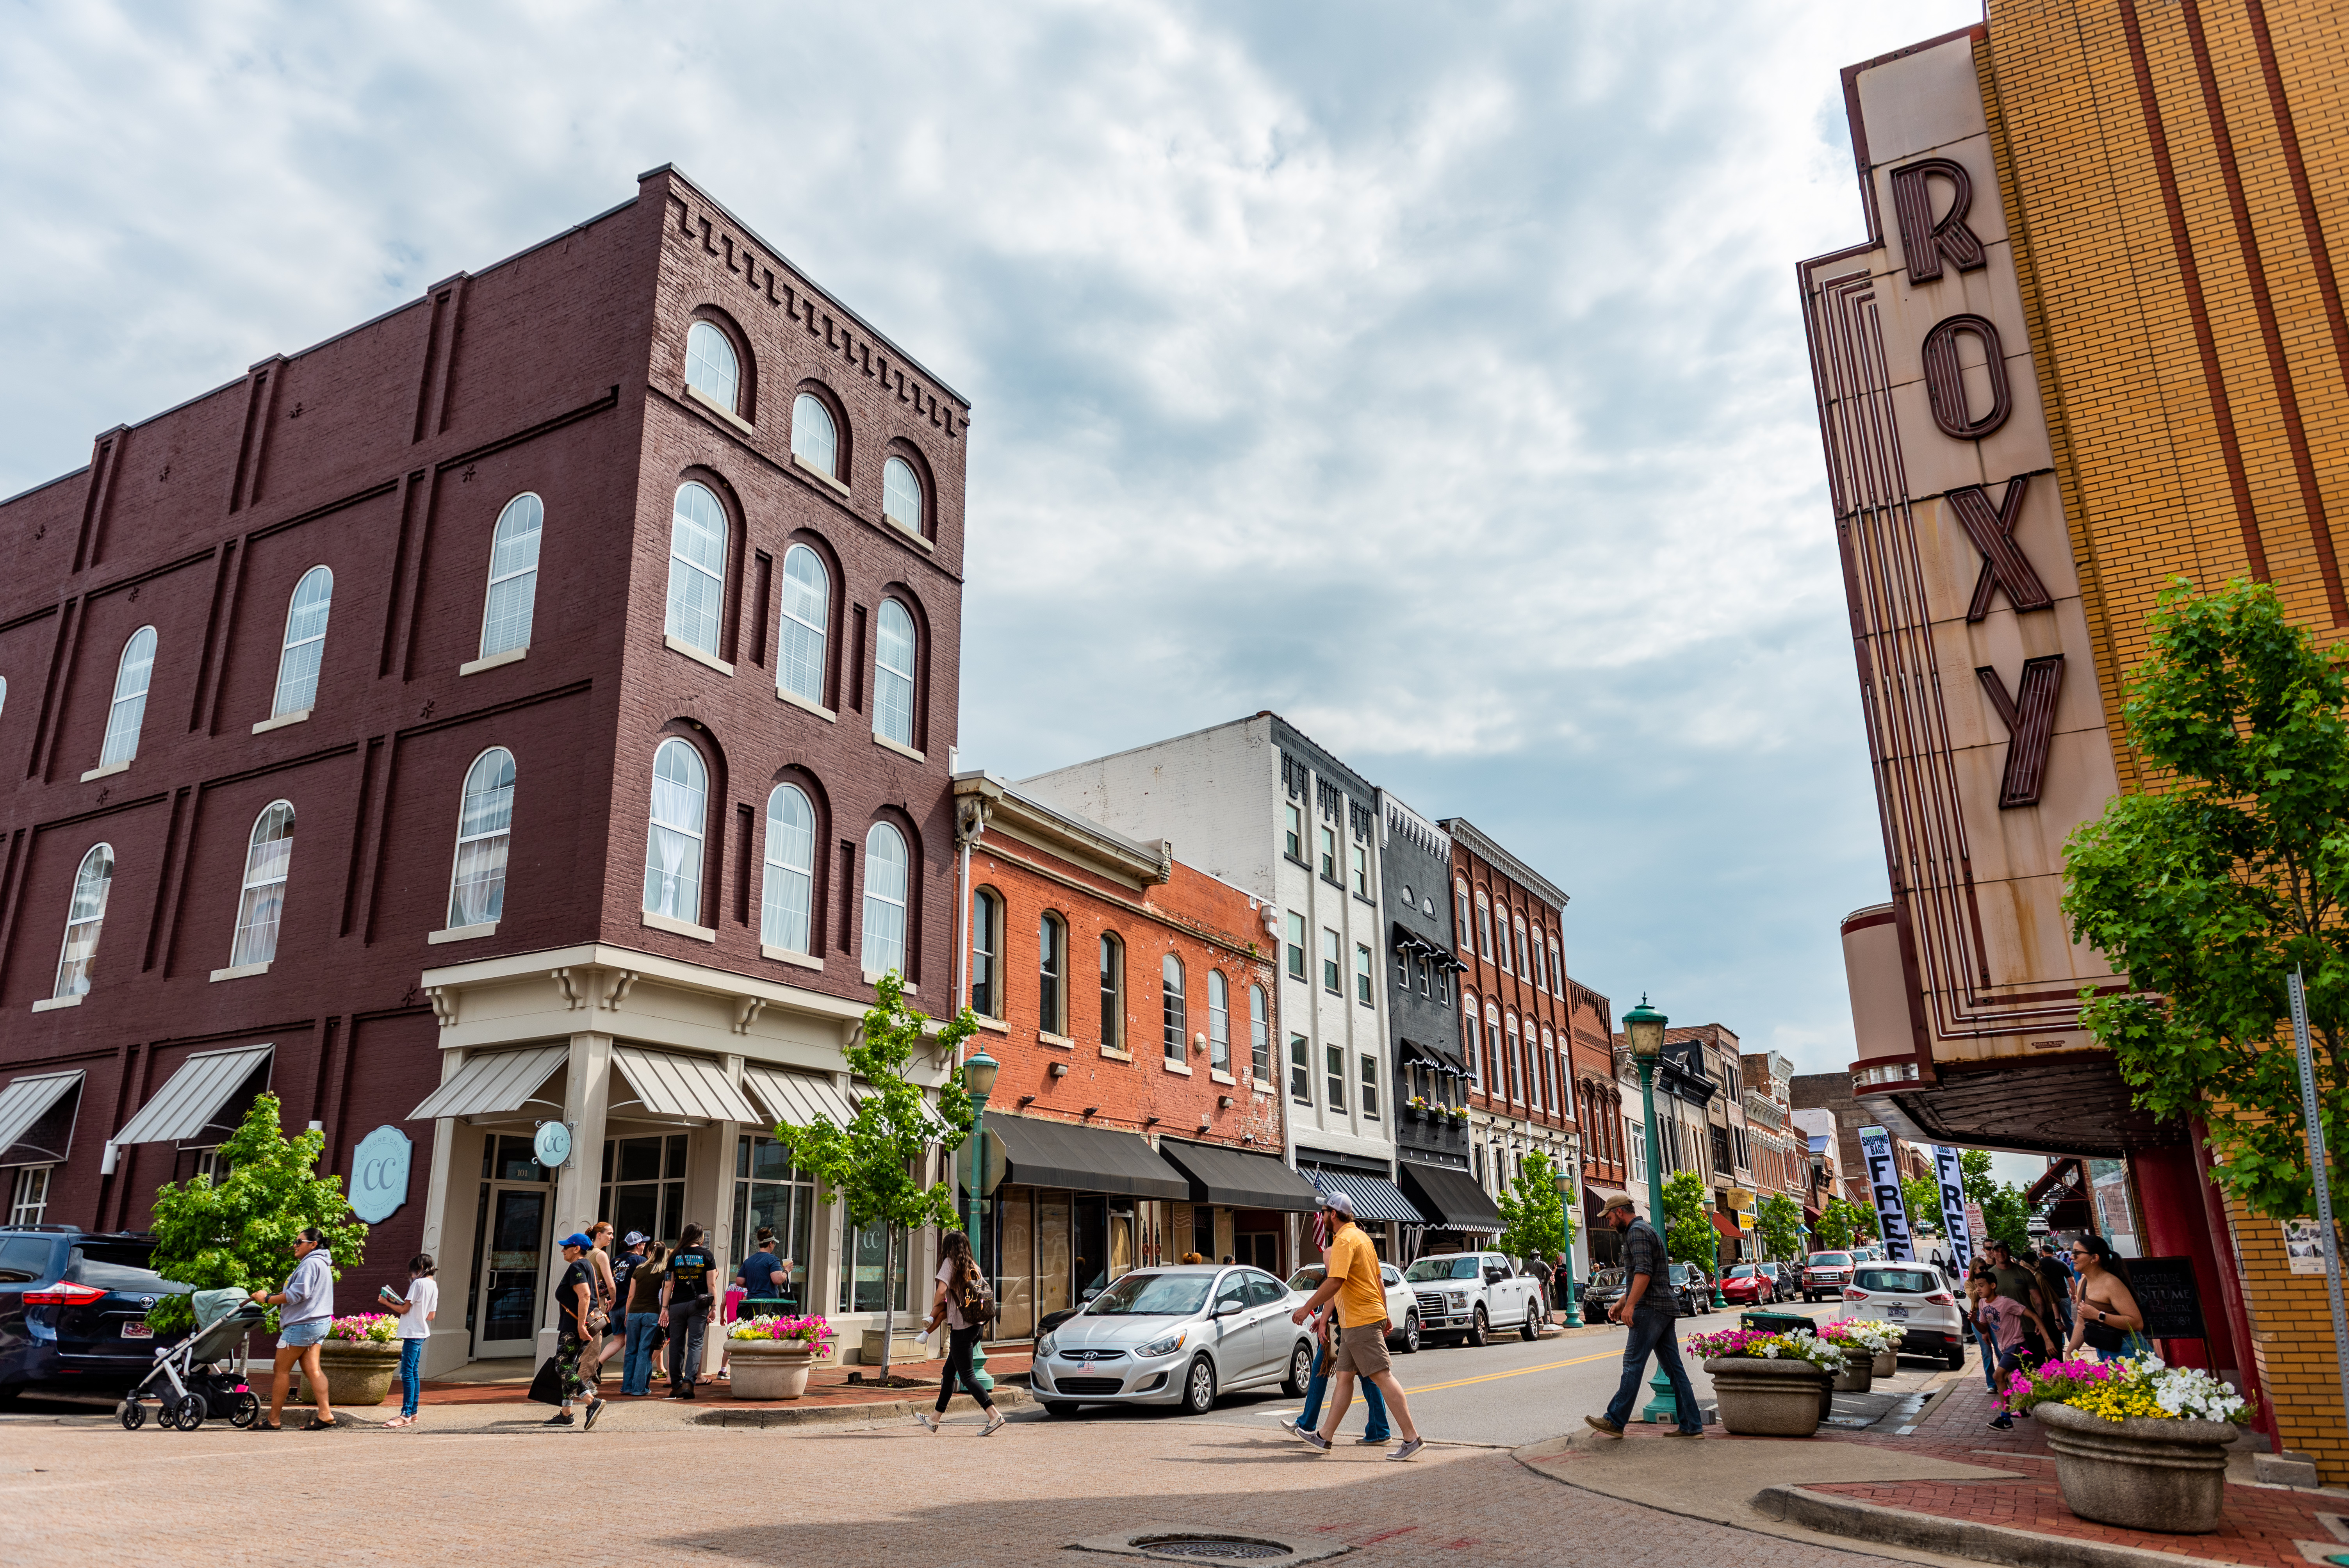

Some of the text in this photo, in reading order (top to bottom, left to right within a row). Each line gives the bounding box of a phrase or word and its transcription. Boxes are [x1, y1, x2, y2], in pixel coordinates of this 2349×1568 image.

[1890, 157, 2064, 809] ROXY
[539, 1124, 557, 1139] COUTURE
[1863, 1128, 1883, 1136] REUSEABLE
[1861, 1134, 1889, 1146] SHOPPING
[358, 1137, 405, 1167] COUTURE CRUSH
[1870, 1144, 1885, 1155] BAGS
[355, 1181, 401, 1212] FASHION INFATUATION
[1936, 1154, 1969, 1269] FREE
[2132, 1273, 2181, 1283] ACKSTAGE
[2140, 1290, 2190, 1299] STUME
[2149, 1299, 2192, 1312] RENTAL
[2144, 1316, 2190, 1326] -552-5589
